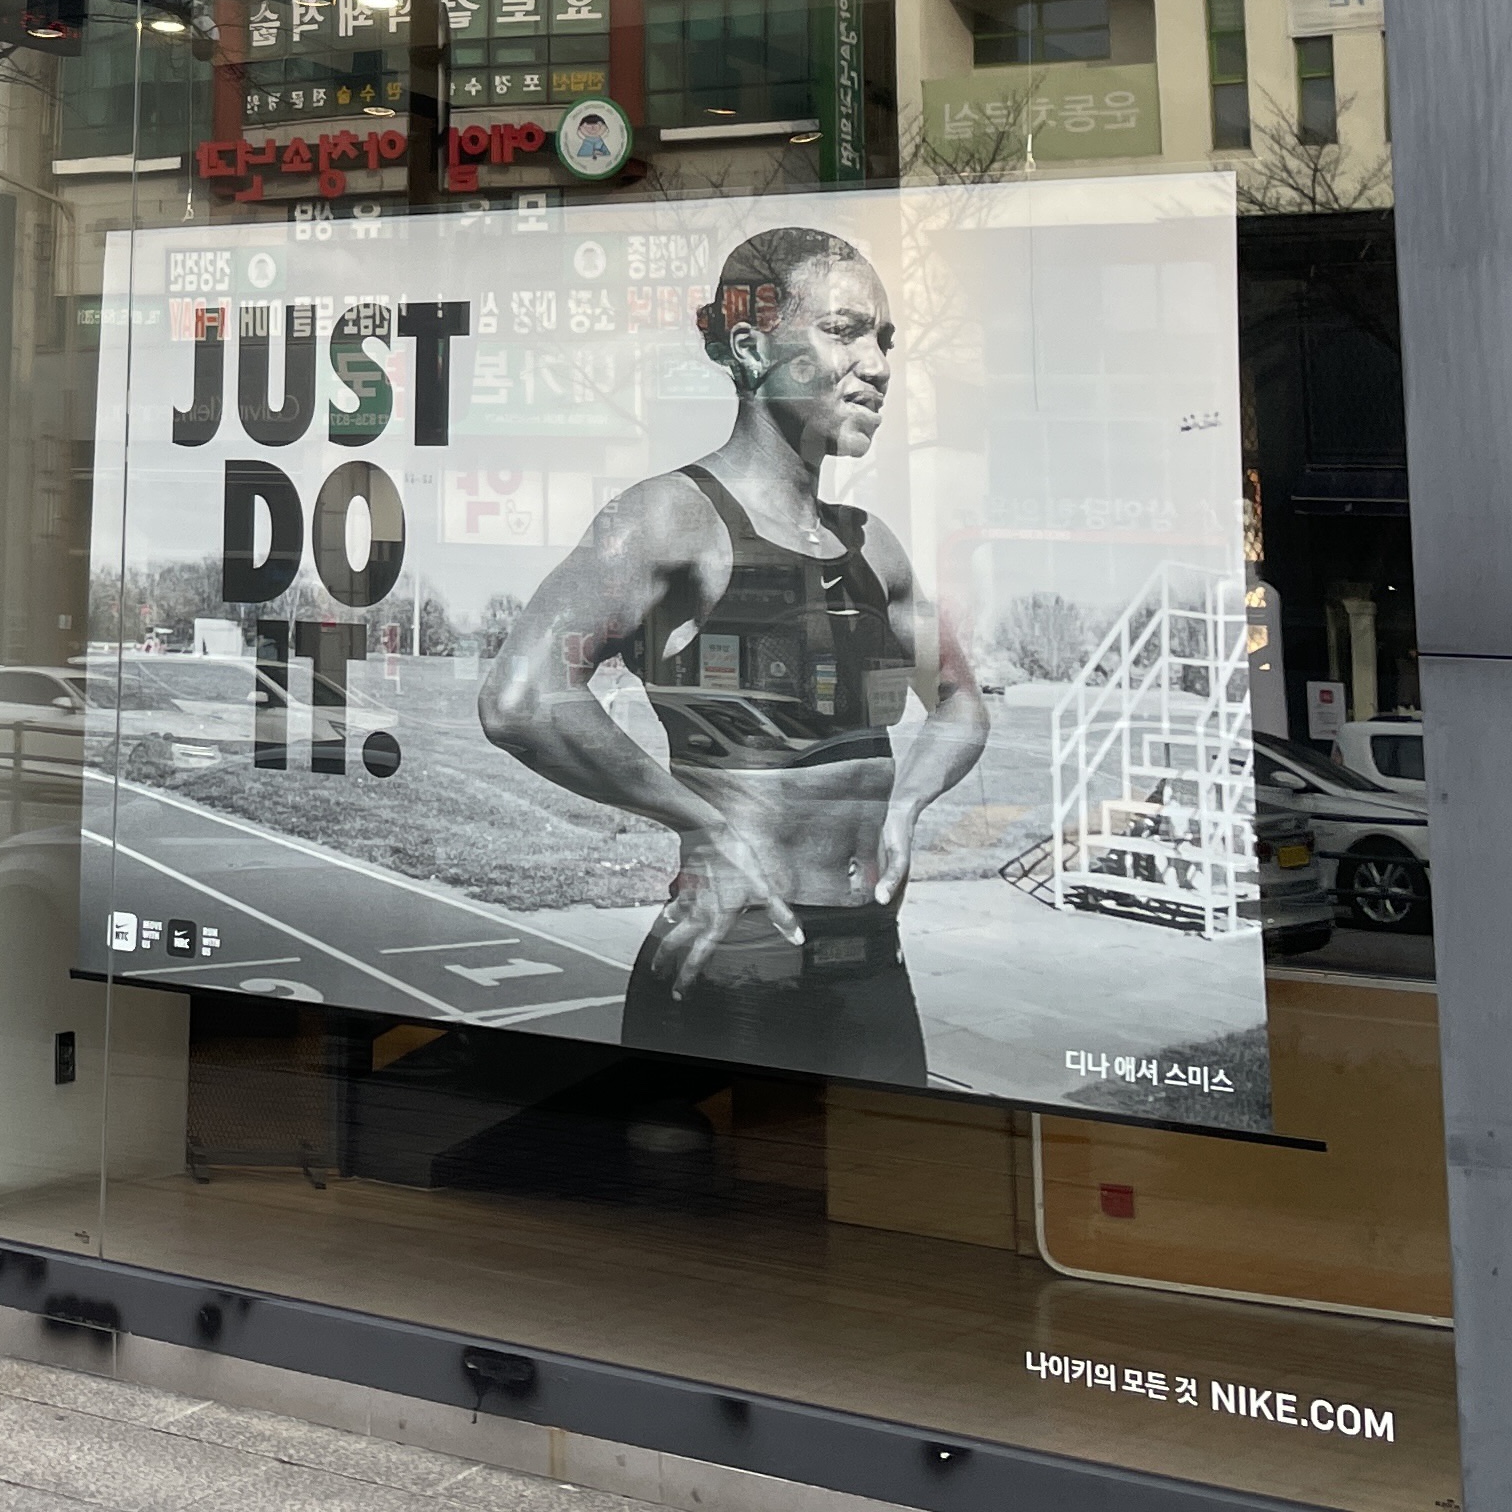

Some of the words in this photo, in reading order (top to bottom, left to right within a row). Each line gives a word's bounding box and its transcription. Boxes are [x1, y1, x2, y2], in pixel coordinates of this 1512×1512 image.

[171, 300, 471, 448] JUST
[222, 459, 406, 607] DO
[253, 619, 402, 778] IT.
[1065, 1049, 1110, 1079] 디나
[1113, 1055, 1159, 1087] 애셔
[1164, 1063, 1236, 1093] 스미스
[1025, 1350, 1117, 1393] 나이키의
[1121, 1367, 1171, 1402] 모든
[1174, 1376, 1199, 1407] 것
[1211, 1380, 1395, 1443] NIKE.COM
